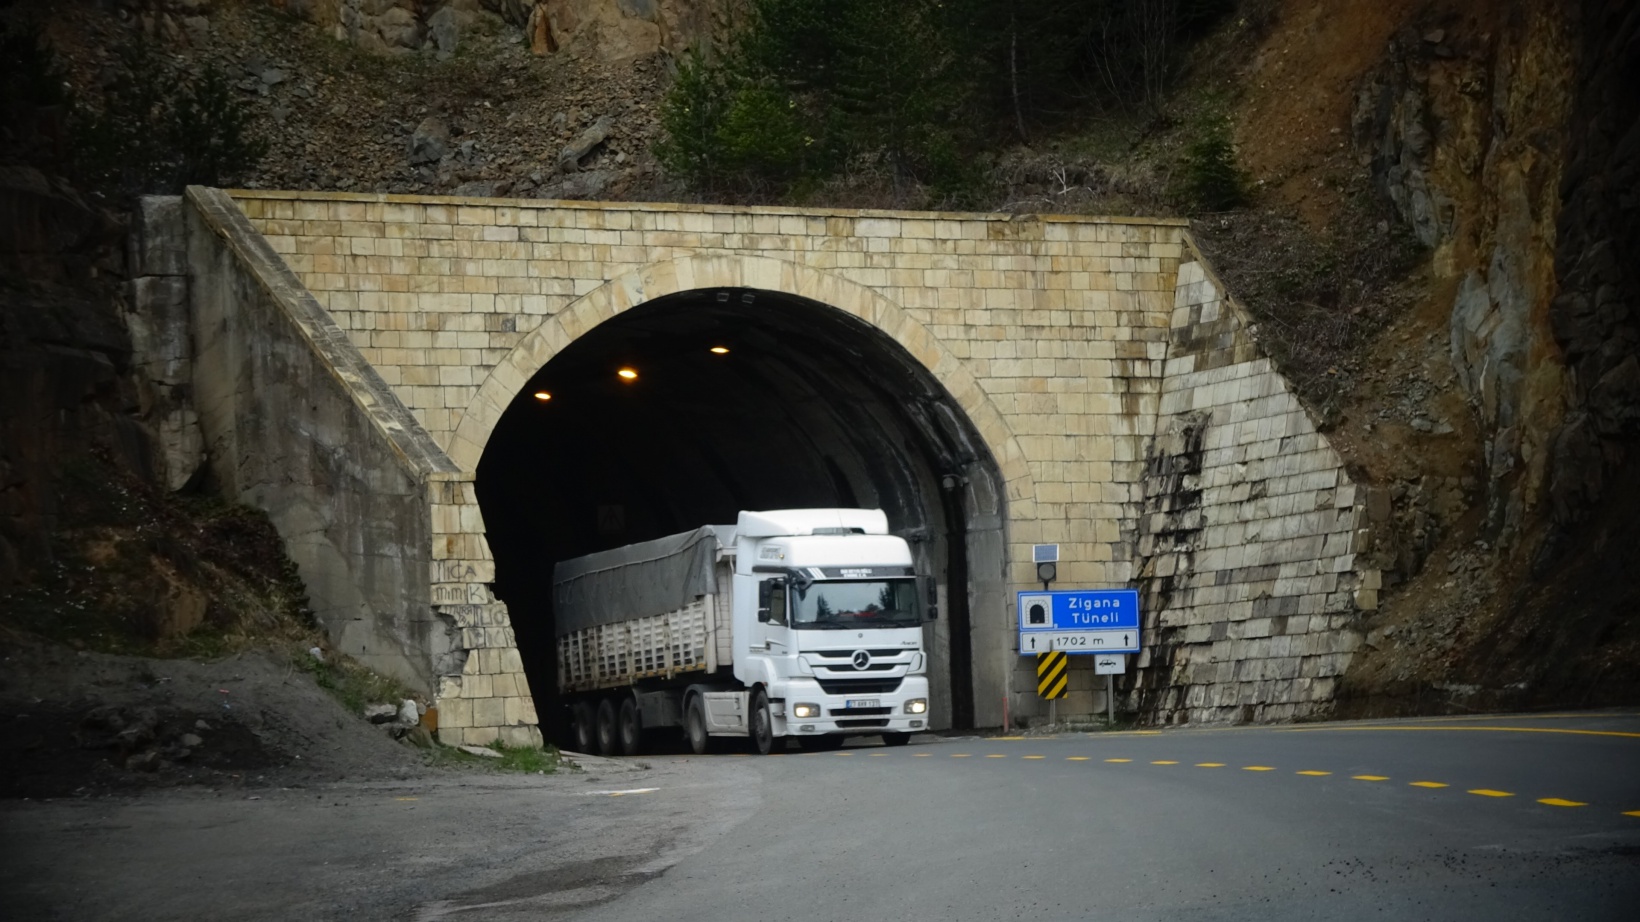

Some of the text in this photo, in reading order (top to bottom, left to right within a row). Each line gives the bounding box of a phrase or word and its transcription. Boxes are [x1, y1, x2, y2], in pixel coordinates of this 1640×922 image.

[1068, 597, 1120, 611] Zigana
[1071, 612, 1119, 624] Tüneli
[1056, 636, 1104, 646] 1702 m
